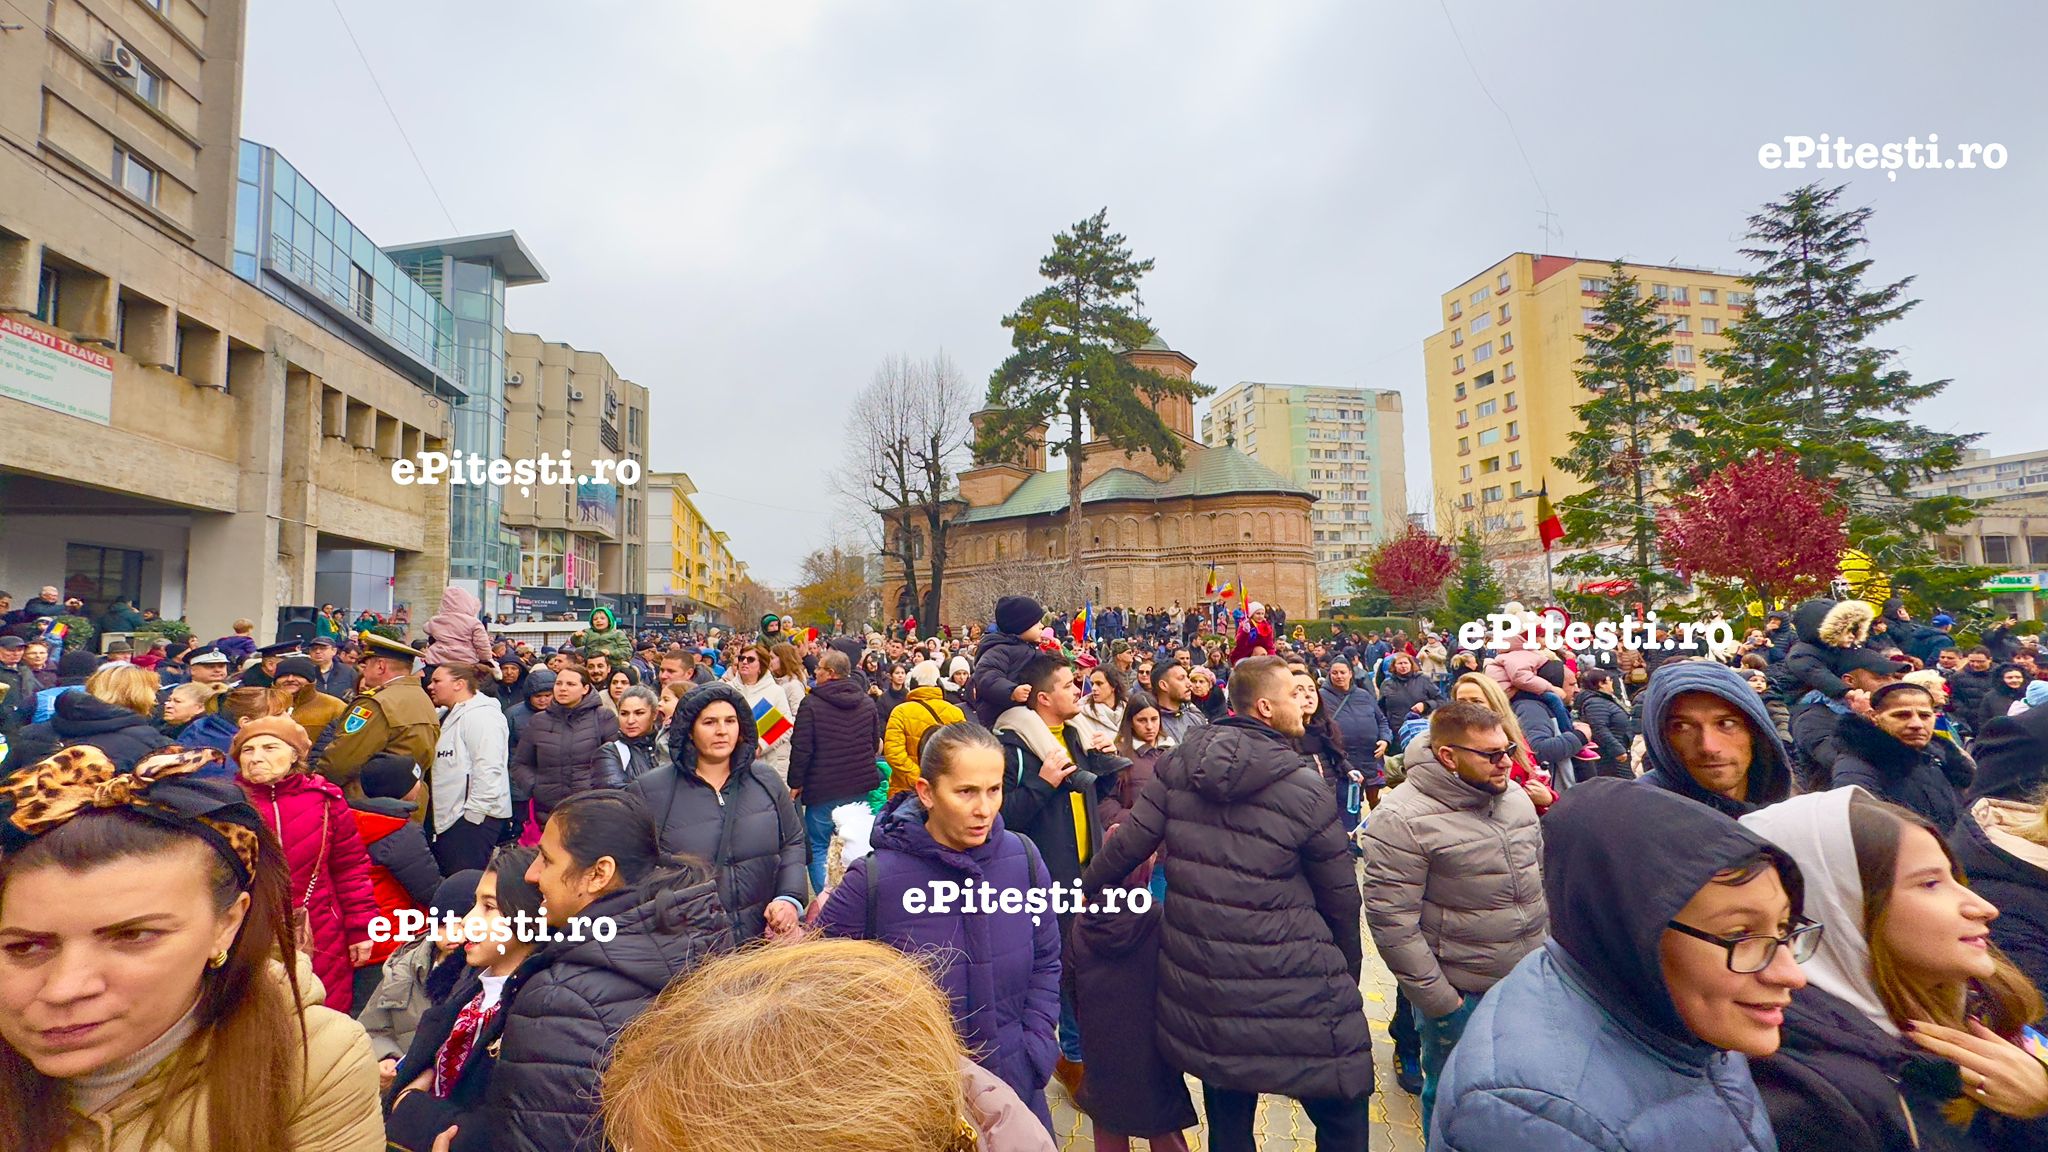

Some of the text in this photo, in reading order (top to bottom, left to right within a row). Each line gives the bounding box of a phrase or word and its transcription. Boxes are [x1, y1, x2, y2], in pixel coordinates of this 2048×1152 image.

[0, 318, 110, 368] ARPATI TRAVEL
[437, 750, 453, 758] HH
